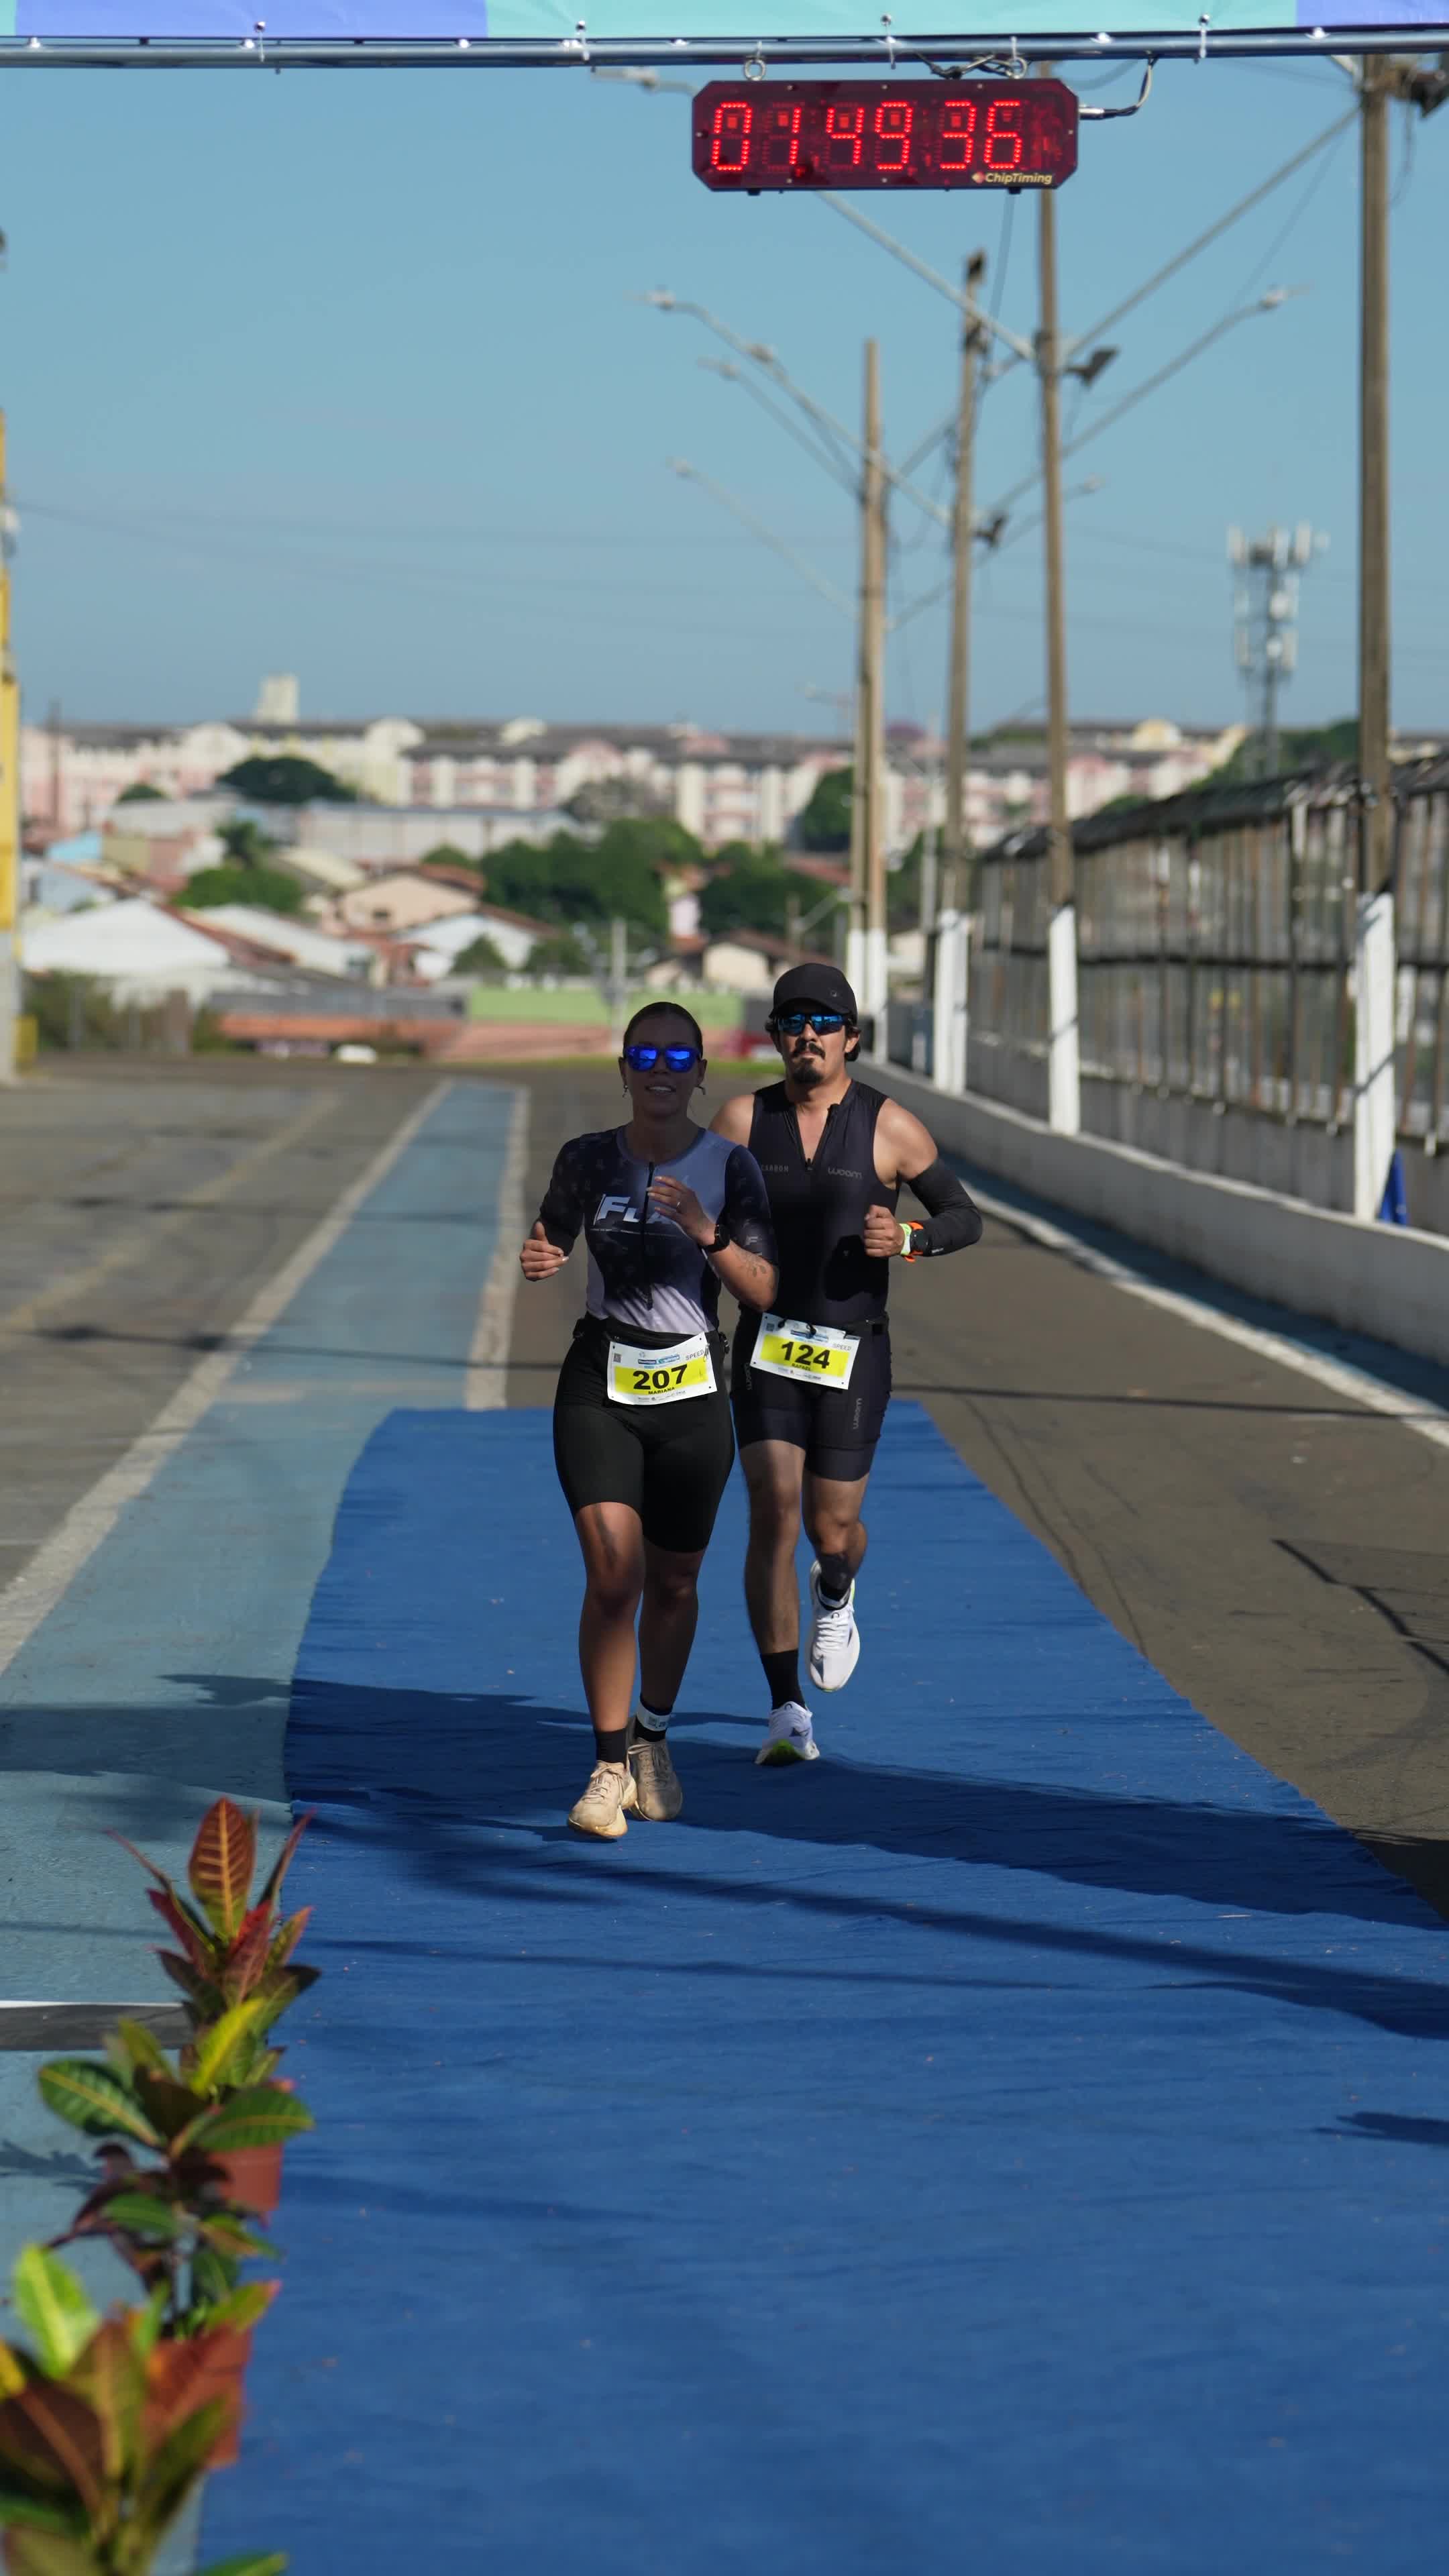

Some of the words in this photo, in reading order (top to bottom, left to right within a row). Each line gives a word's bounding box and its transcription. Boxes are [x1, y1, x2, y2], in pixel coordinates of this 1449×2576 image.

[986, 172, 1053, 184] ChipTiming
[833, 1342, 852, 1351] SPEED
[686, 1350, 704, 1360] SPEED
[782, 1342, 830, 1369] 124
[633, 1364, 688, 1390] 207
[648, 1387, 675, 1395] MARIANA
